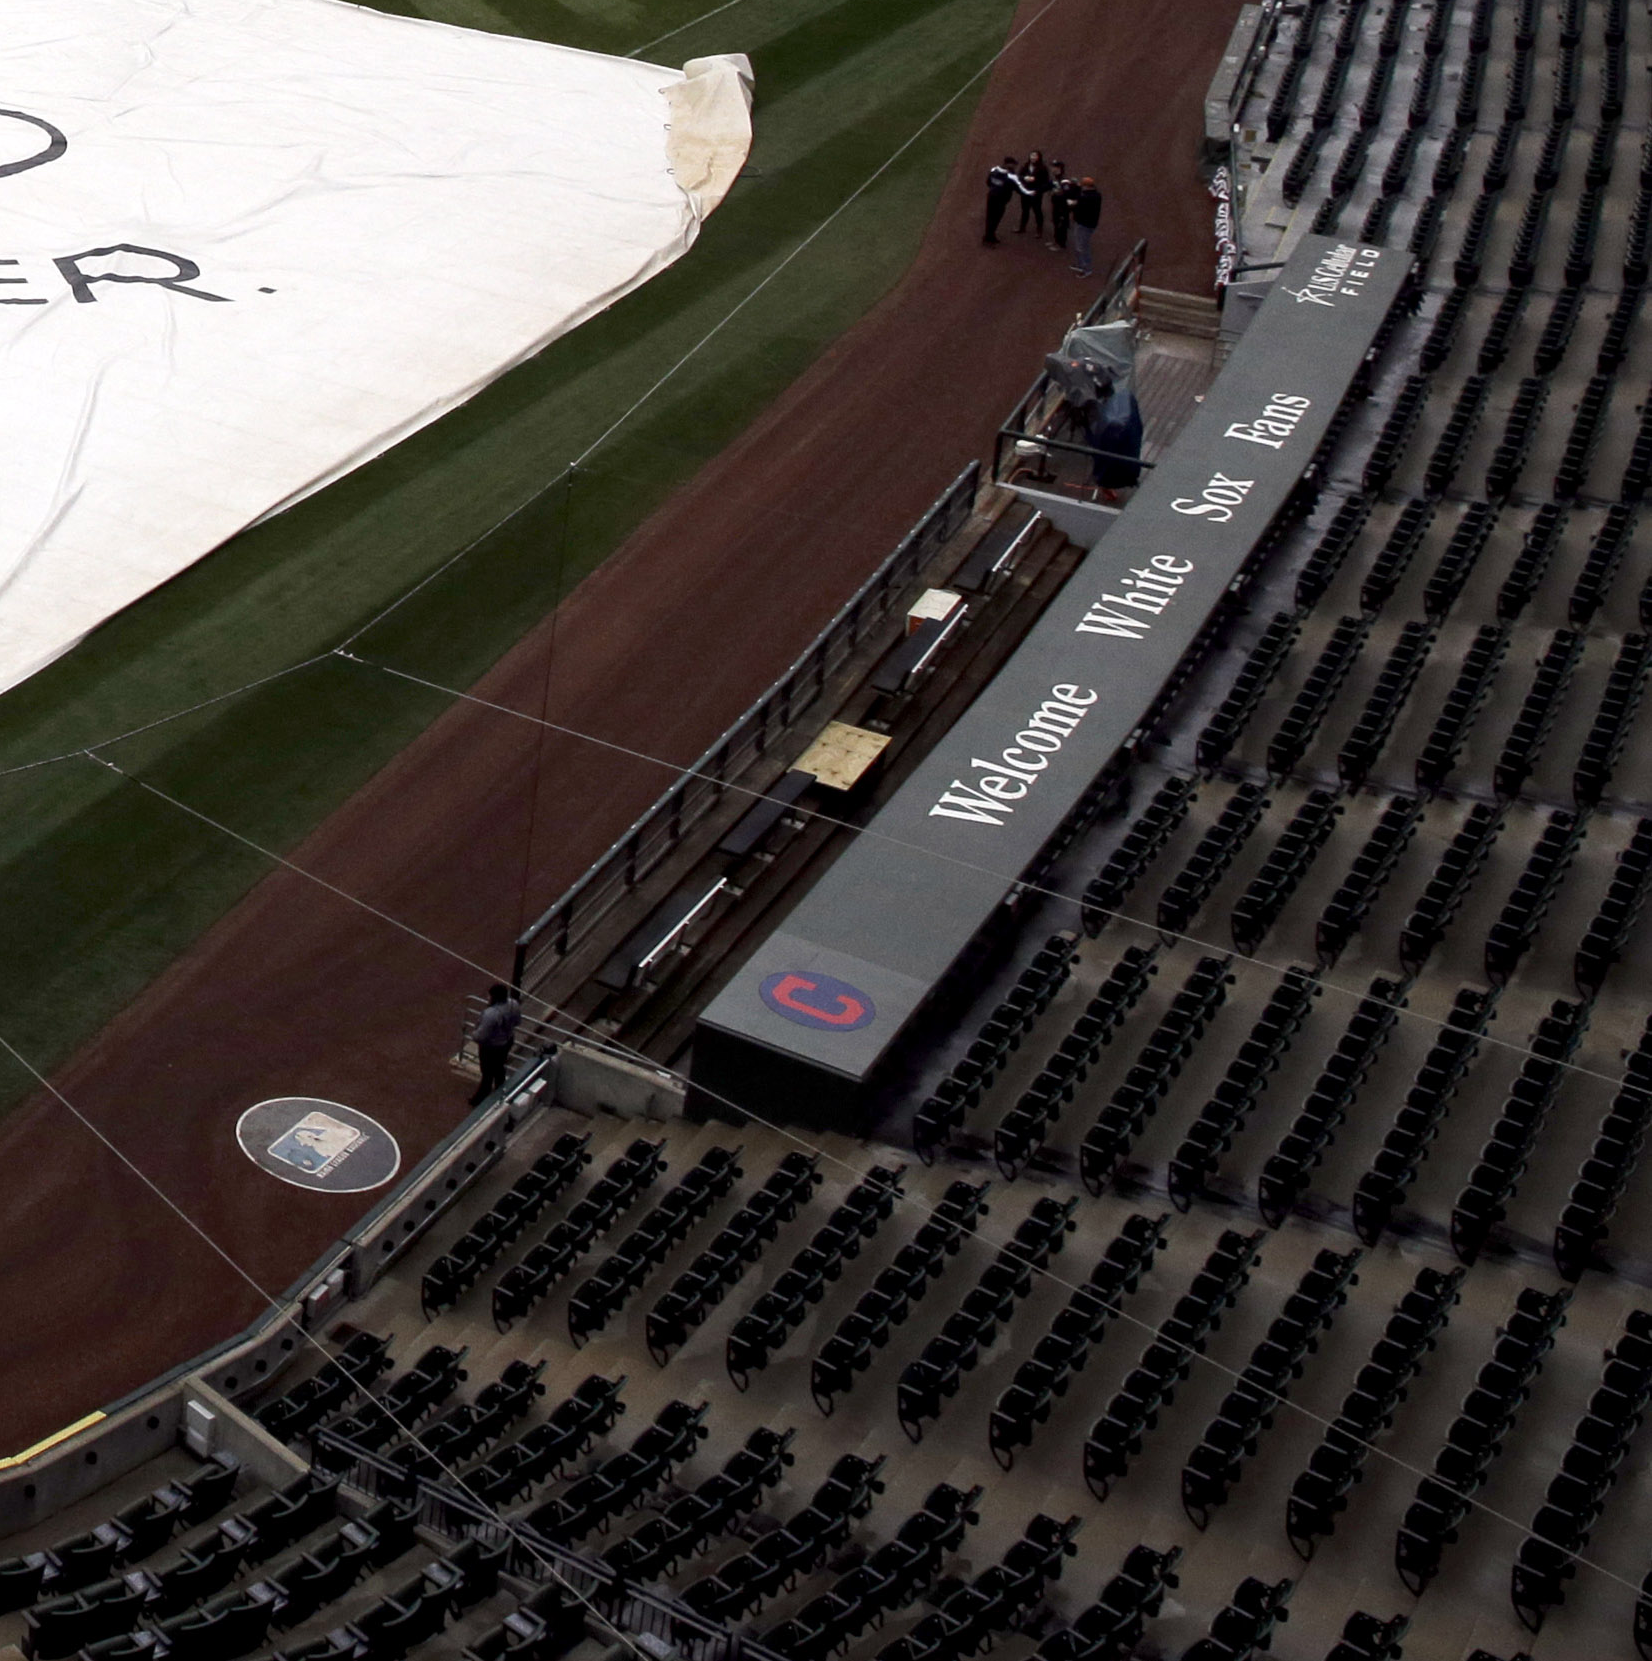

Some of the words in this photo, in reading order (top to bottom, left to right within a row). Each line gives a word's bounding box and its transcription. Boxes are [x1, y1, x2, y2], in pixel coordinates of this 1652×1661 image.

[1340, 248, 1381, 296] FIELD
[929, 678, 1098, 829] Welcome
[1077, 550, 1195, 644] White
[1170, 470, 1255, 524] Sox
[1224, 390, 1311, 450] Fans
